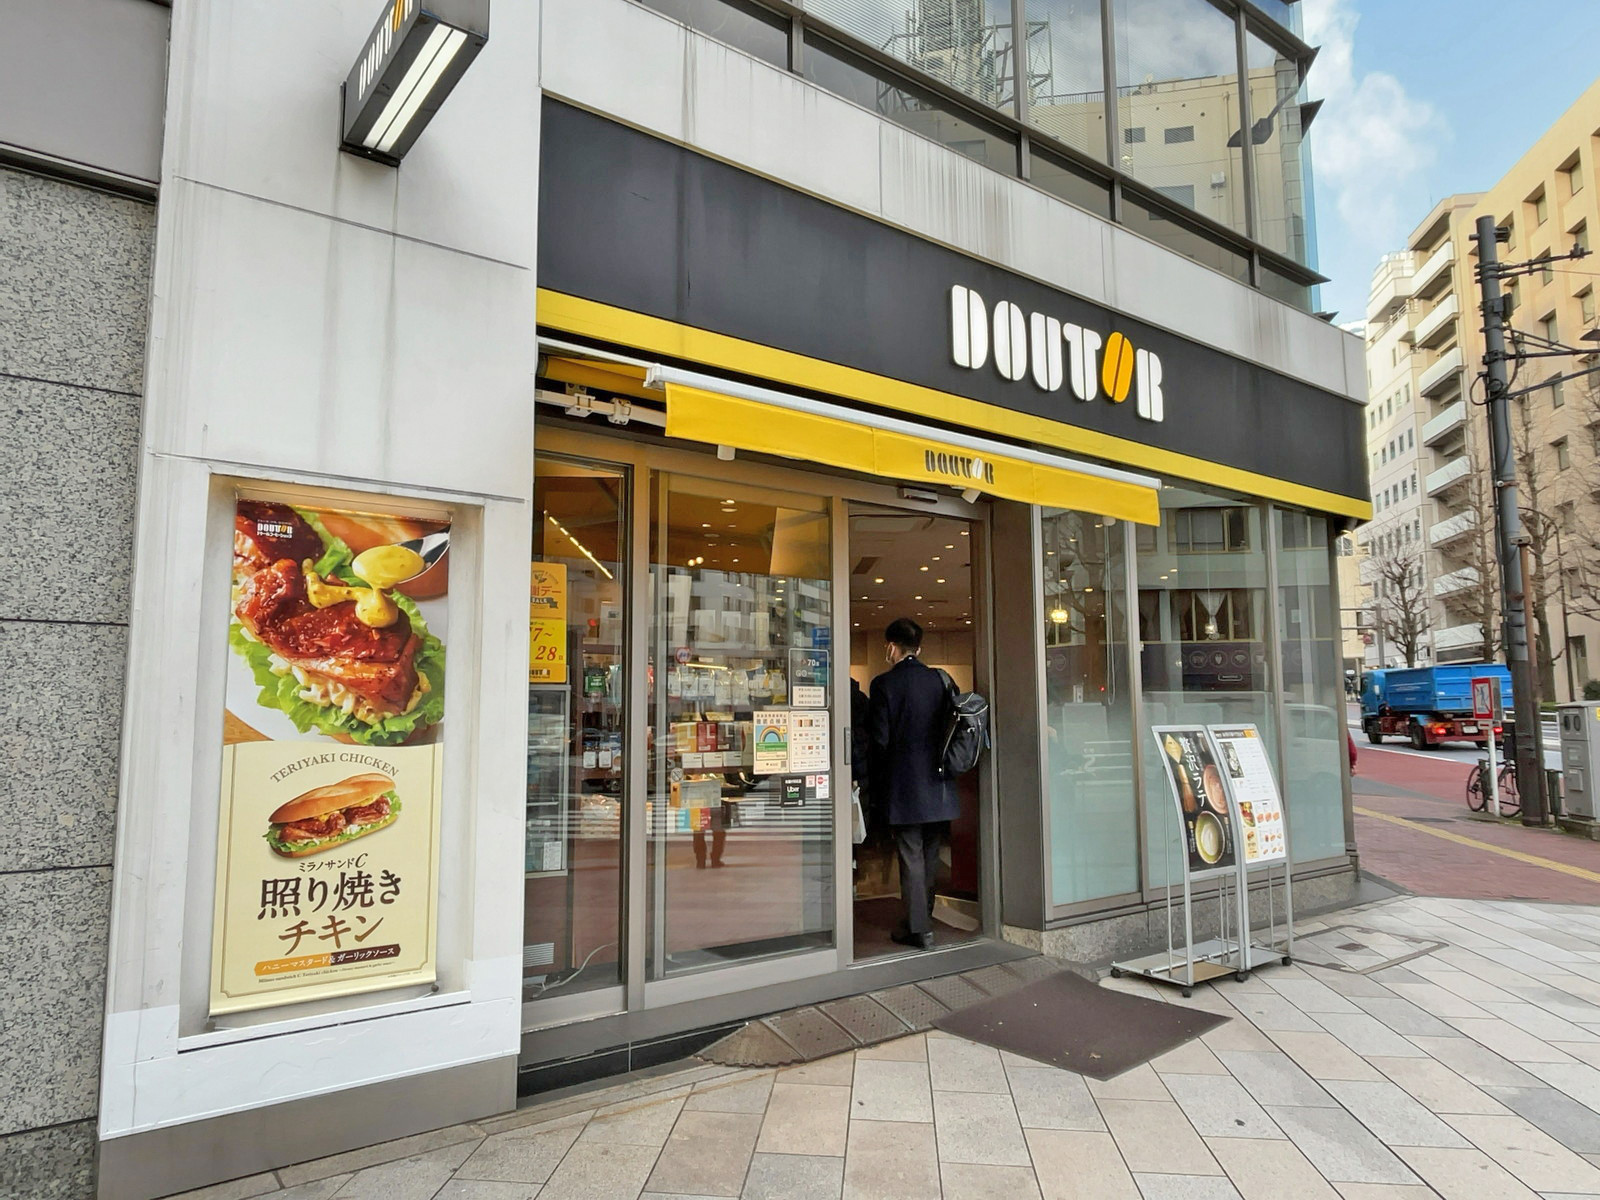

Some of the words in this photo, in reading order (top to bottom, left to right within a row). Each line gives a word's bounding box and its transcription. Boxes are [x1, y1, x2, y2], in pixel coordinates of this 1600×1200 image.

[952, 284, 1163, 422] DOUTOR
[925, 449, 994, 485] DOUTOR
[257, 523, 293, 534] DOUTOR
[270, 753, 336, 784] TERIYAKI
[339, 752, 399, 777] CHICKEN
[257, 869, 402, 920] 照り焼き
[278, 915, 384, 956] チキン
